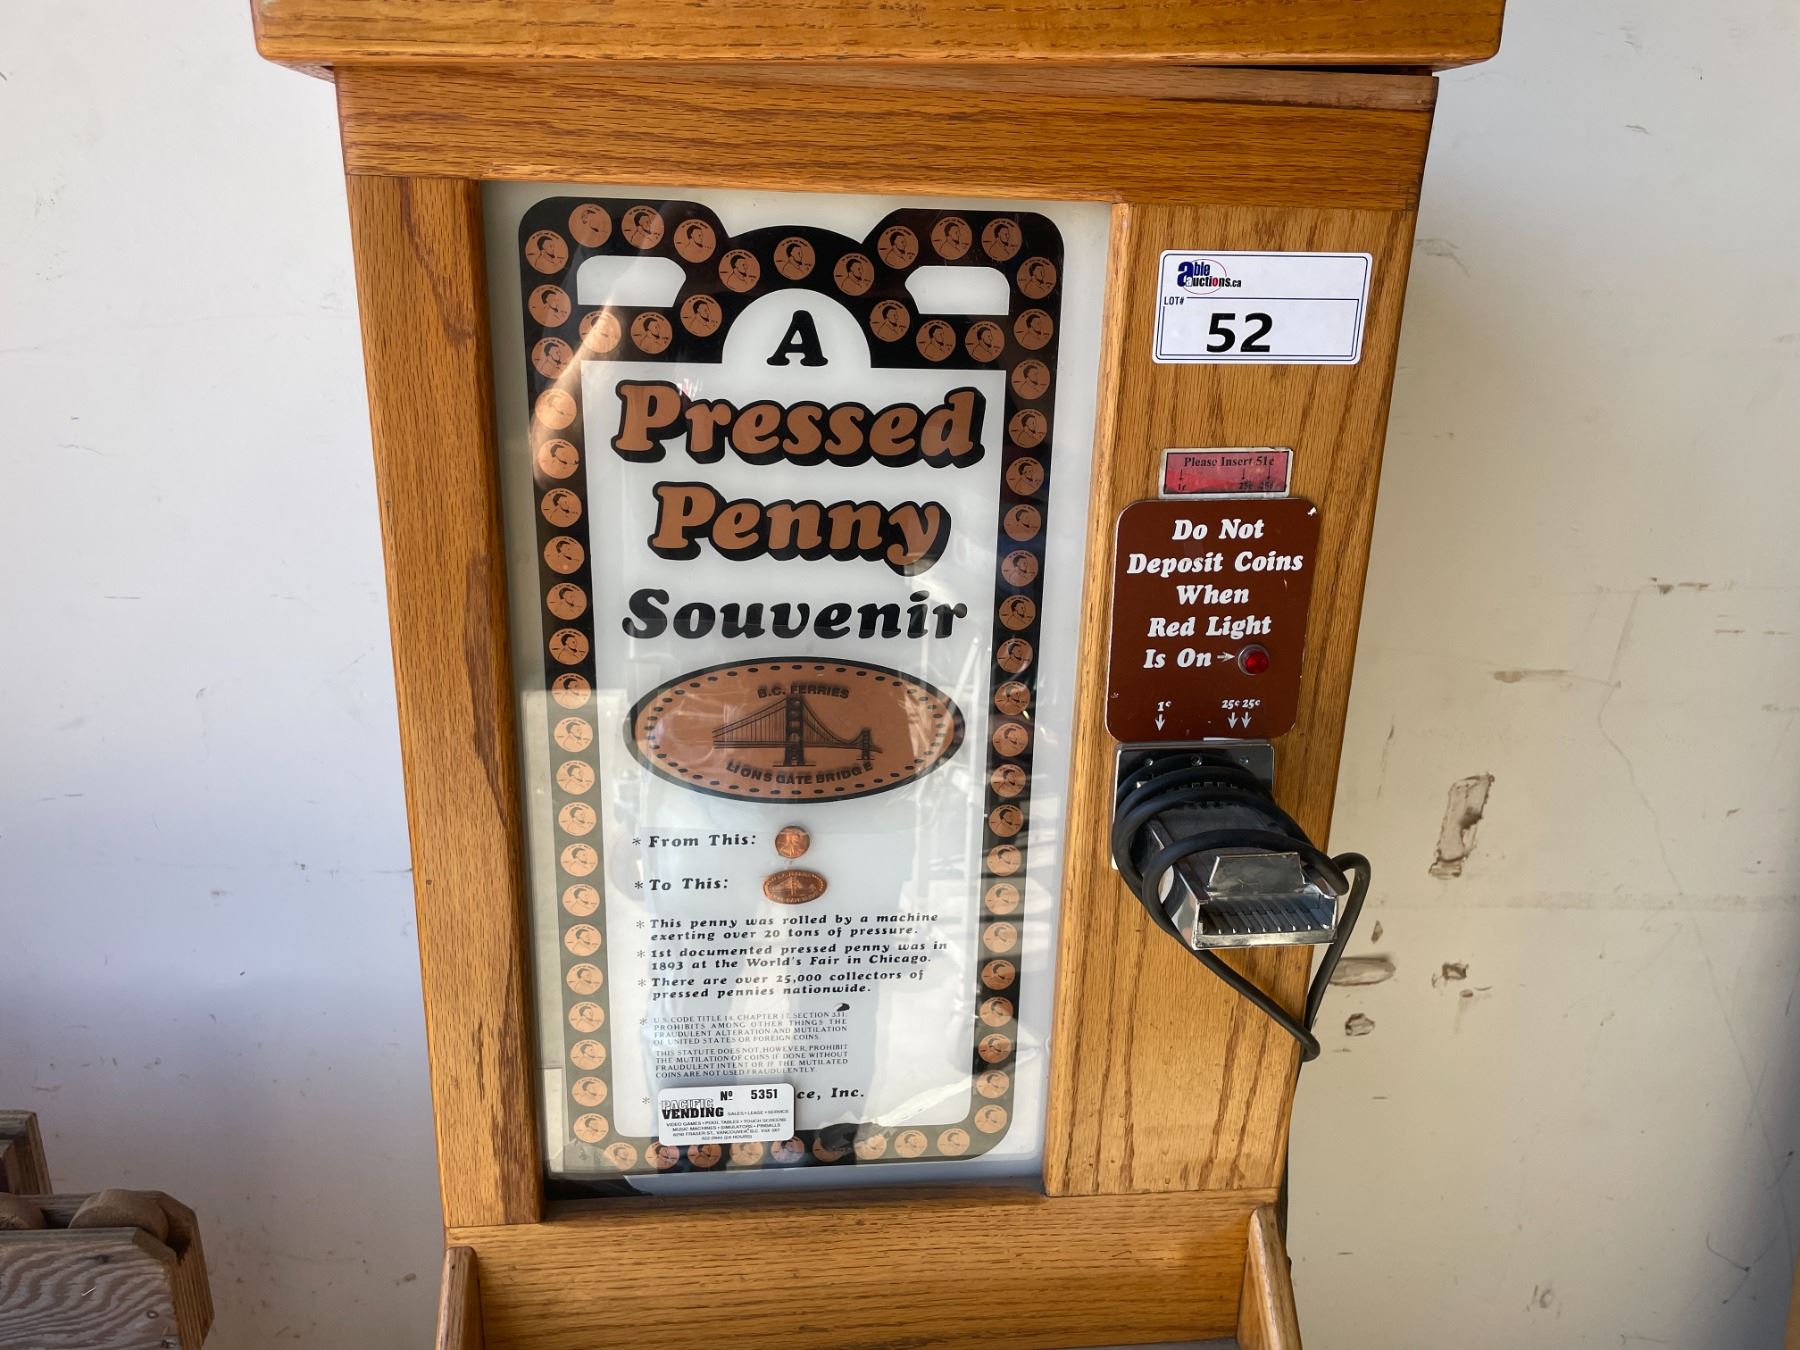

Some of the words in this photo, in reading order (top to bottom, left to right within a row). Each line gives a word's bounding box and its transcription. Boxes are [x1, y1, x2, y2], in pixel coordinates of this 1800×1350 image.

[1177, 261, 1211, 287] able
[1164, 296, 1185, 305] LOT#
[766, 310, 829, 367] A
[1206, 312, 1273, 353] 52
[611, 379, 986, 469] Pressed
[1184, 457, 1218, 467] Please
[1221, 456, 1252, 467] Insert
[647, 481, 952, 576] Penny
[1172, 519, 1208, 541] Do
[1218, 518, 1265, 540] Not
[1126, 552, 1224, 578] Deposit
[1234, 550, 1304, 572] Coins
[1176, 584, 1249, 605] When
[622, 588, 968, 639] Souvenir
[1147, 616, 1196, 637] Red
[1205, 615, 1272, 640] Light
[1143, 648, 1166, 668] Is
[1177, 648, 1212, 668] On
[757, 684, 786, 698] B.C.
[790, 683, 850, 699] FERRIES
[725, 760, 773, 782] LIONS
[775, 773, 813, 784] GATE
[815, 762, 873, 784] BRIDGE
[648, 835, 699, 848] From
[708, 834, 756, 846] This:
[649, 879, 671, 891] To
[682, 877, 728, 890] This:
[650, 918, 682, 929] This
[690, 918, 738, 929] penny
[745, 917, 774, 926] was
[782, 914, 827, 925] rolled
[835, 914, 852, 926] by
[860, 915, 869, 923] a
[876, 912, 939, 923] machine
[651, 930, 715, 941] exerting
[723, 930, 757, 939] over
[764, 929, 781, 938] 20
[788, 928, 820, 937] tons
[827, 926, 843, 938] of
[850, 926, 918, 938] pressure.
[651, 949, 672, 958] 1st
[679, 945, 773, 957] documented
[780, 943, 837, 956] pressed
[844, 943, 890, 954] penny
[898, 942, 926, 951] was
[933, 941, 948, 950] in
[652, 961, 684, 971] 1893
[691, 960, 708, 969] at
[715, 959, 738, 968] the
[746, 956, 802, 967] World's
[810, 956, 840, 965] Fair
[847, 955, 861, 964] in
[869, 954, 931, 965] Chicago.
[652, 977, 695, 987] There
[703, 976, 728, 985] are
[735, 975, 768, 984] over
[776, 973, 822, 984] 25,000
[829, 971, 902, 982] collectors
[909, 969, 924, 981] of
[652, 988, 709, 1001] pressed
[717, 986, 775, 999] pennies
[783, 984, 871, 996] nationwide.
[737, 1013, 780, 1021] CHAPTER
[654, 1022, 706, 1031] PROHIBITS
[654, 1030, 711, 1038] FRAUDULENT
[716, 1028, 770, 1037] ALTERATION
[794, 1026, 847, 1034] MUTILATION
[668, 1037, 700, 1045] UNITED
[753, 1034, 790, 1042] FOREIGN
[676, 1055, 729, 1063] MUTILATION
[677, 1048, 715, 1056] STATUTE
[655, 1063, 714, 1071] FRAUDULENT
[750, 1088, 778, 1100] 5351
[796, 1091, 821, 1101] ce,
[831, 1087, 864, 1098] Inc.
[661, 1098, 714, 1109] PACIFIC
[662, 1106, 724, 1119] VENDING
